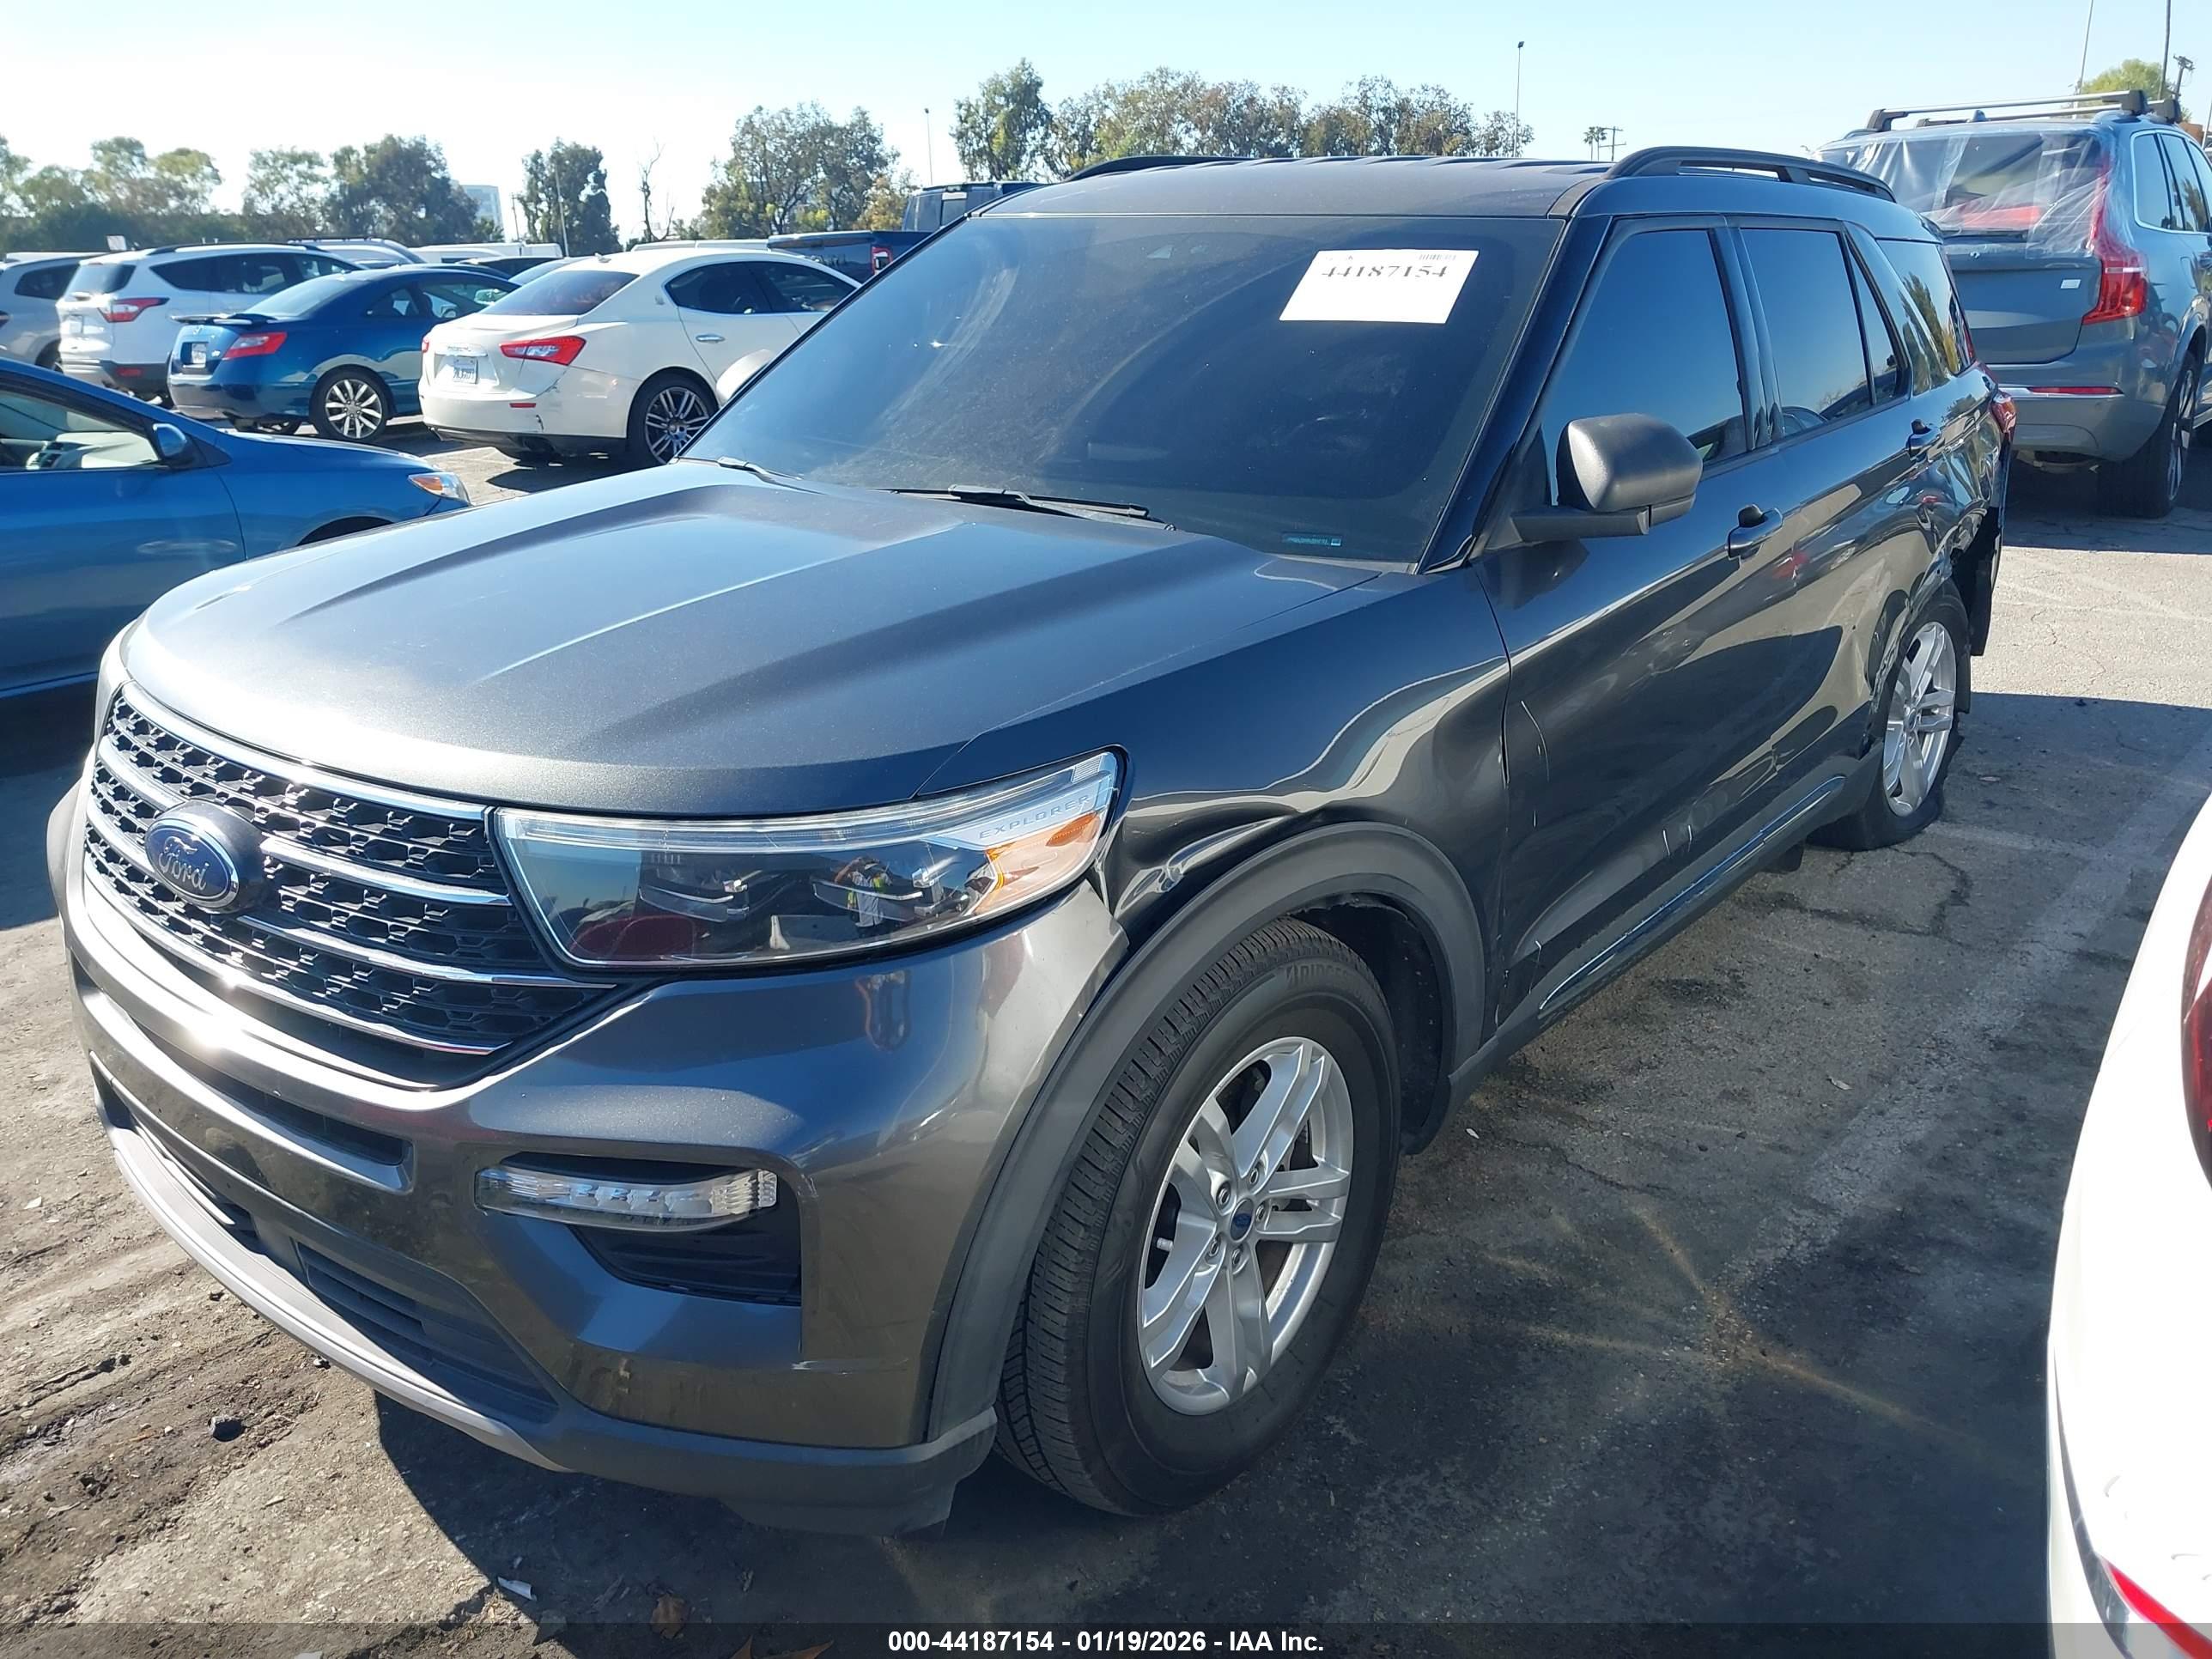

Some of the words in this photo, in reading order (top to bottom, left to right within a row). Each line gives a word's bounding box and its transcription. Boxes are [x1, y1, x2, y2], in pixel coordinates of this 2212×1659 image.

[1321, 264, 1448, 278] 44187154
[978, 794, 1091, 840] EXPLORER
[157, 836, 210, 891] Ford
